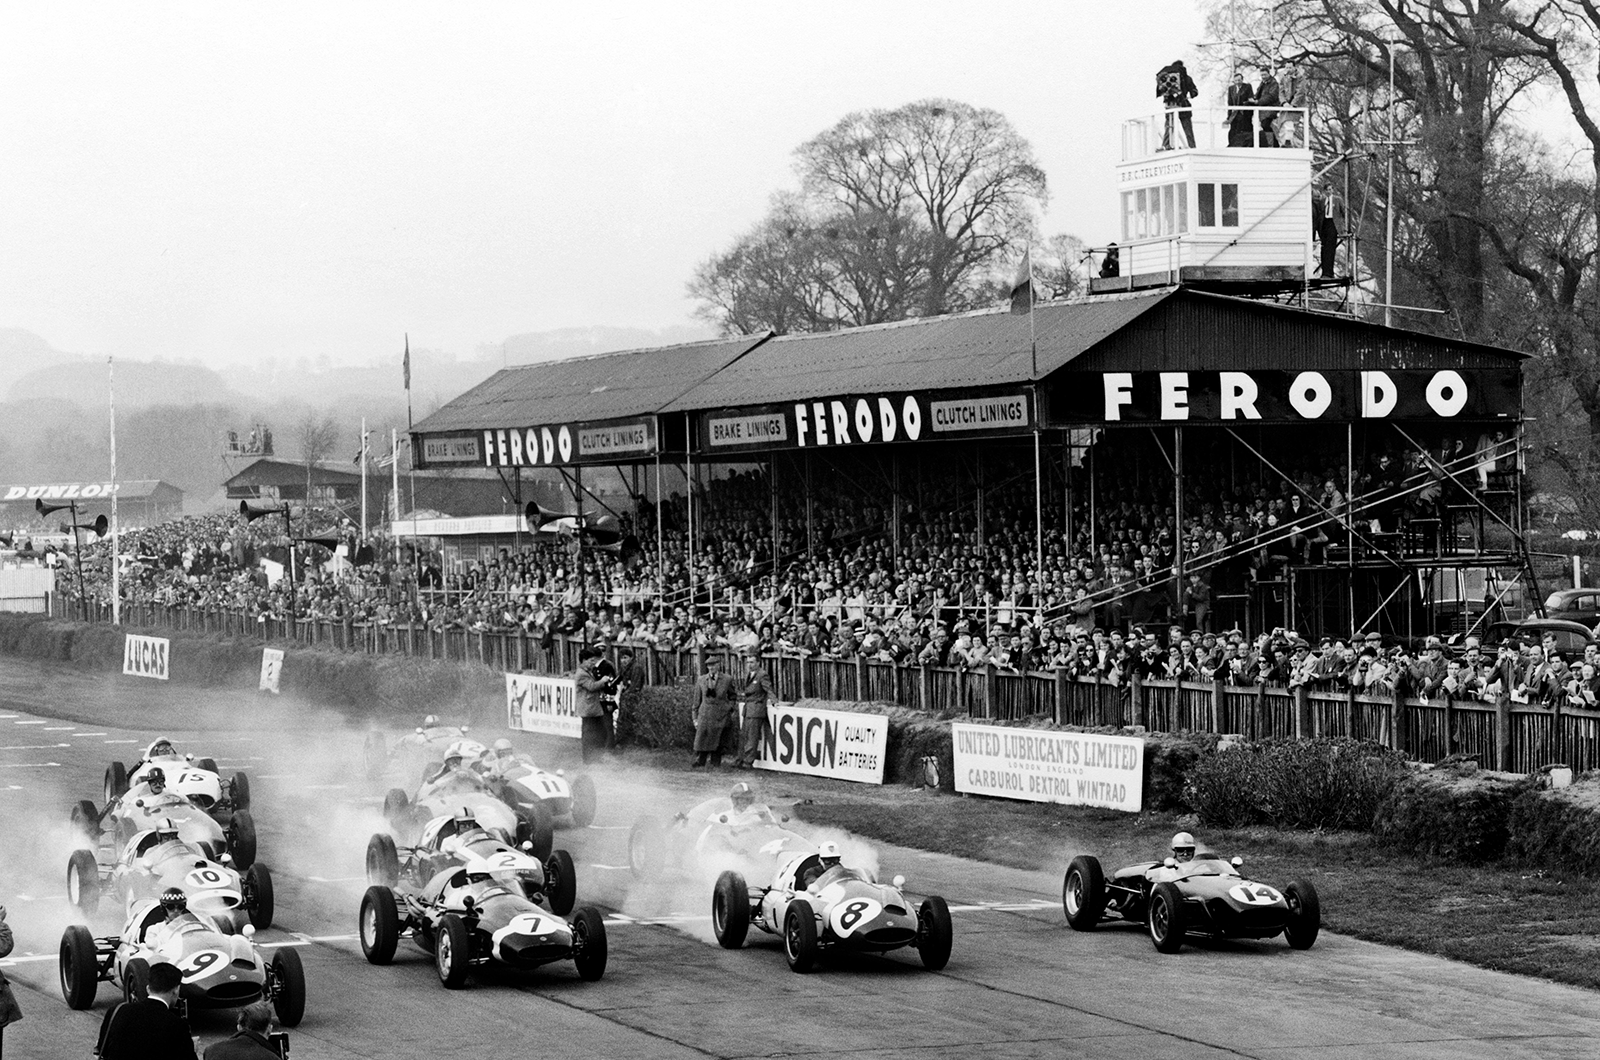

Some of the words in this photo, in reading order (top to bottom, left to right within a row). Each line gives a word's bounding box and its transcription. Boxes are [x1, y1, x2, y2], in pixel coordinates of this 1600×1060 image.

[1103, 370, 1468, 421] FERODO
[795, 396, 921, 446] FERODO
[936, 405, 977, 425] CLUTCH
[980, 401, 1022, 422] LININGS
[713, 421, 741, 440] BRAKE
[747, 418, 782, 437] LININGS
[483, 425, 572, 467] FERODO
[582, 432, 611, 449] CLUTCH
[613, 430, 644, 447] LININGS
[427, 443, 448, 457] BRAKE
[451, 442, 475, 456] LININGS
[4, 484, 120, 500] DUNLOP
[126, 637, 165, 676] LUCAS
[529, 682, 552, 716] JOHN
[556, 686, 579, 718] BUL
[757, 714, 838, 769] NSIGN
[845, 726, 877, 744] QUALITY
[457, 743, 481, 753] 12
[958, 730, 1000, 757] UNITED
[1004, 734, 1079, 765] LUBRICANTS
[1084, 741, 1137, 771] LIMITED
[839, 751, 877, 770] BATTERIES
[1009, 762, 1041, 771] LONDON
[1047, 764, 1083, 775] ENGLAND
[178, 772, 206, 784] 15
[541, 780, 561, 793] 11
[968, 768, 1024, 791] CARBUROL
[1029, 775, 1071, 797] DEXTROL
[1077, 779, 1126, 803] WINTRAD
[759, 837, 790, 855] 4
[499, 855, 516, 867] 2
[190, 870, 220, 885] 10
[1240, 887, 1278, 902] 14
[523, 916, 541, 934] 7
[840, 902, 869, 930] 8
[182, 952, 219, 978] 9
